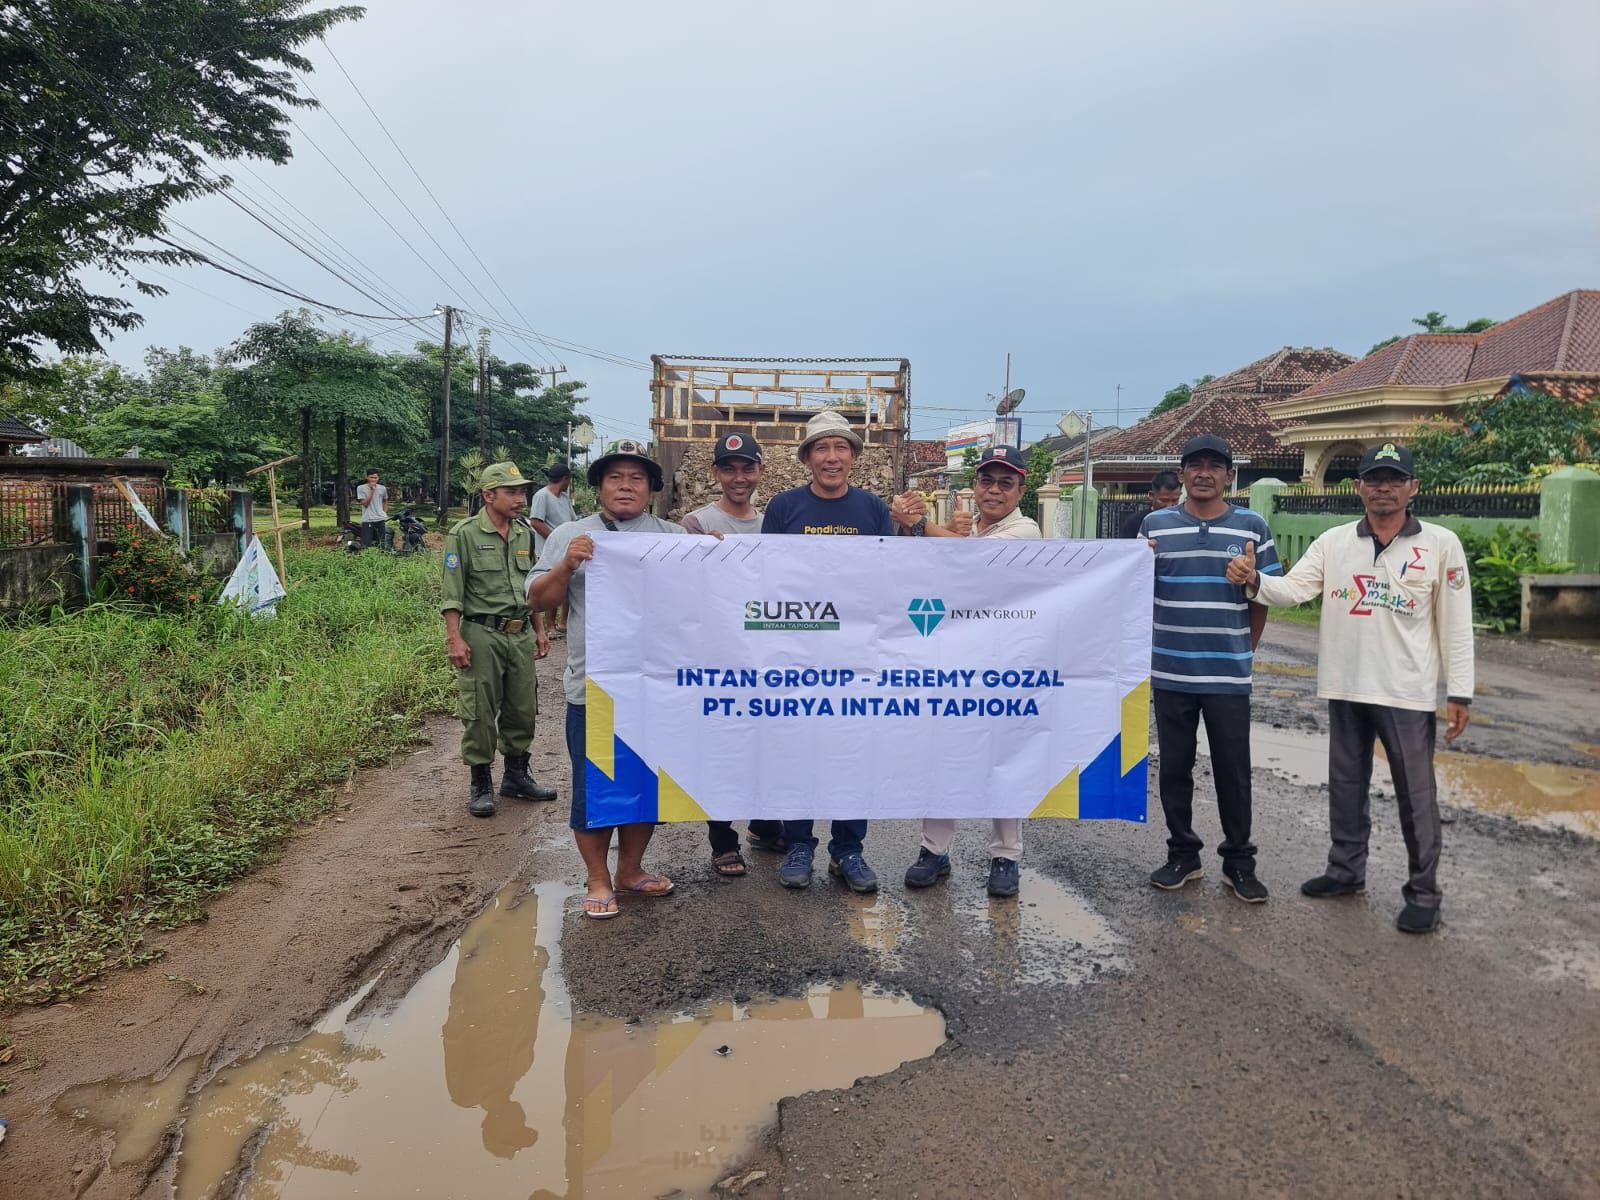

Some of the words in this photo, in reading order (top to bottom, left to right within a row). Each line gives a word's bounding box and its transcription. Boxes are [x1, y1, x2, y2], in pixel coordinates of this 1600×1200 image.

[804, 524, 859, 535] Pendidikan
[744, 599, 841, 620] SURYA
[950, 609, 991, 620] INTAN
[993, 609, 1037, 620] GROUP
[762, 622, 786, 630] INTAN
[788, 622, 820, 630] TAPIOKA
[677, 668, 758, 688] INTAN
[764, 668, 855, 688] GROUP
[877, 668, 976, 688] JEREMY
[982, 669, 1065, 688] GOZAL
[703, 697, 742, 717] PT.
[748, 697, 835, 717] SURYA
[841, 697, 920, 717] INTAN
[926, 697, 1040, 717] TAPIOKA
